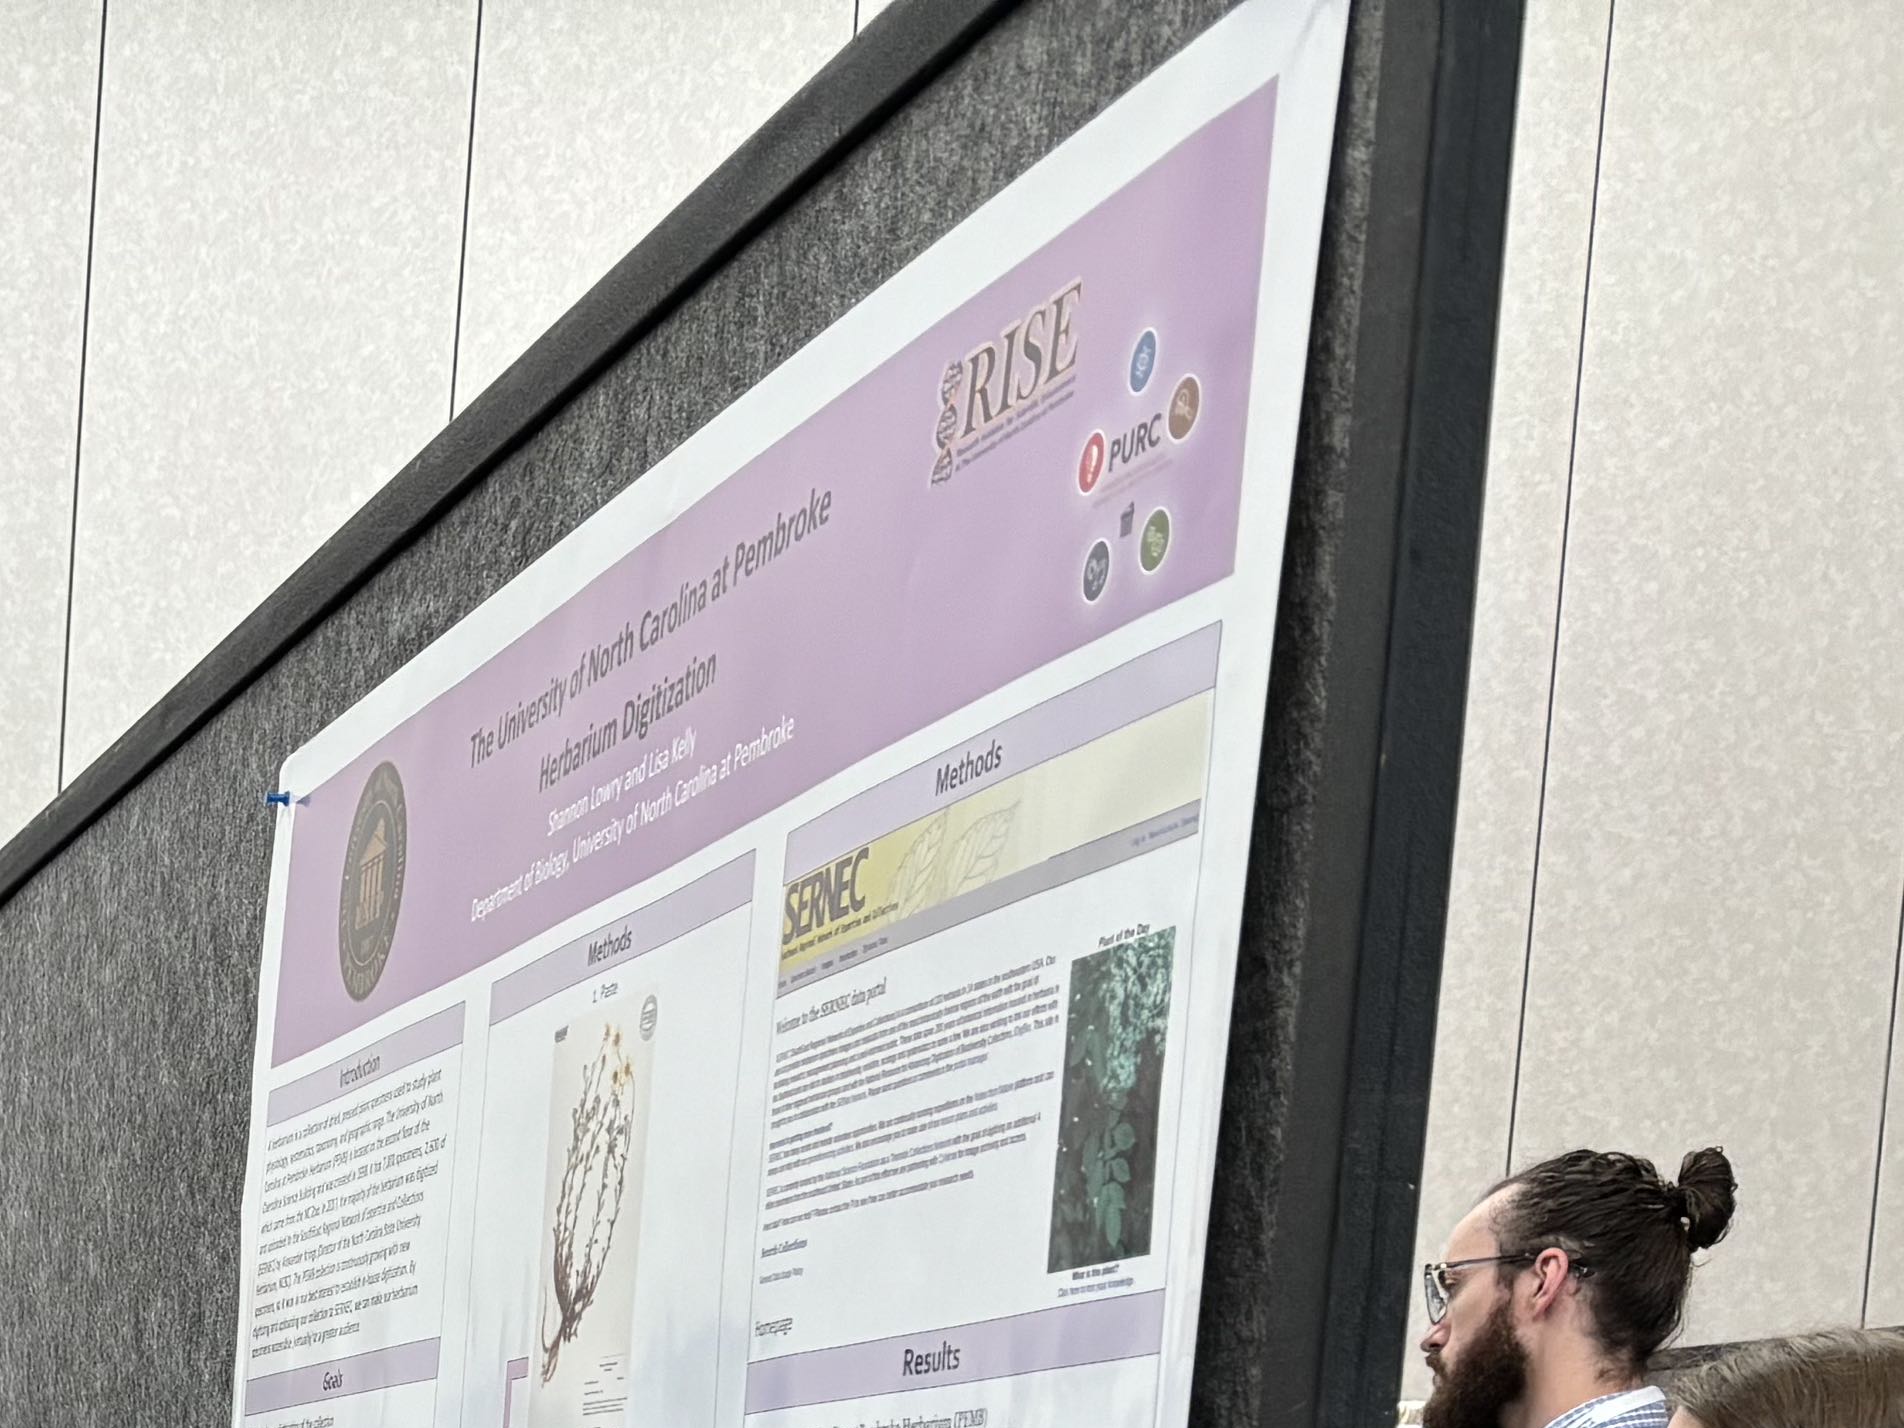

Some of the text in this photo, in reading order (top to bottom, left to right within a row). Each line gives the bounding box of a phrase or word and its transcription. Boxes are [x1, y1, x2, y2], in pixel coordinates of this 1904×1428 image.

[961, 282, 1082, 438] RISE
[1108, 413, 1162, 472] PURC
[471, 490, 830, 767] The University of North Carolina at Pembroke
[539, 656, 715, 790] Herbarium Digitization
[934, 741, 1002, 793] Methods
[472, 877, 521, 920] Department
[524, 863, 534, 890] of
[572, 819, 621, 861] University
[626, 803, 638, 833] of
[641, 787, 671, 823] North
[674, 765, 716, 805] Carolina
[718, 753, 729, 778] at
[734, 717, 793, 768] Pembroke
[548, 727, 696, 835] Shannon Lowry and Lisa Kelly
[587, 927, 631, 964] Methods
[782, 847, 869, 945] SERNEC
[902, 1342, 960, 1374] Results
